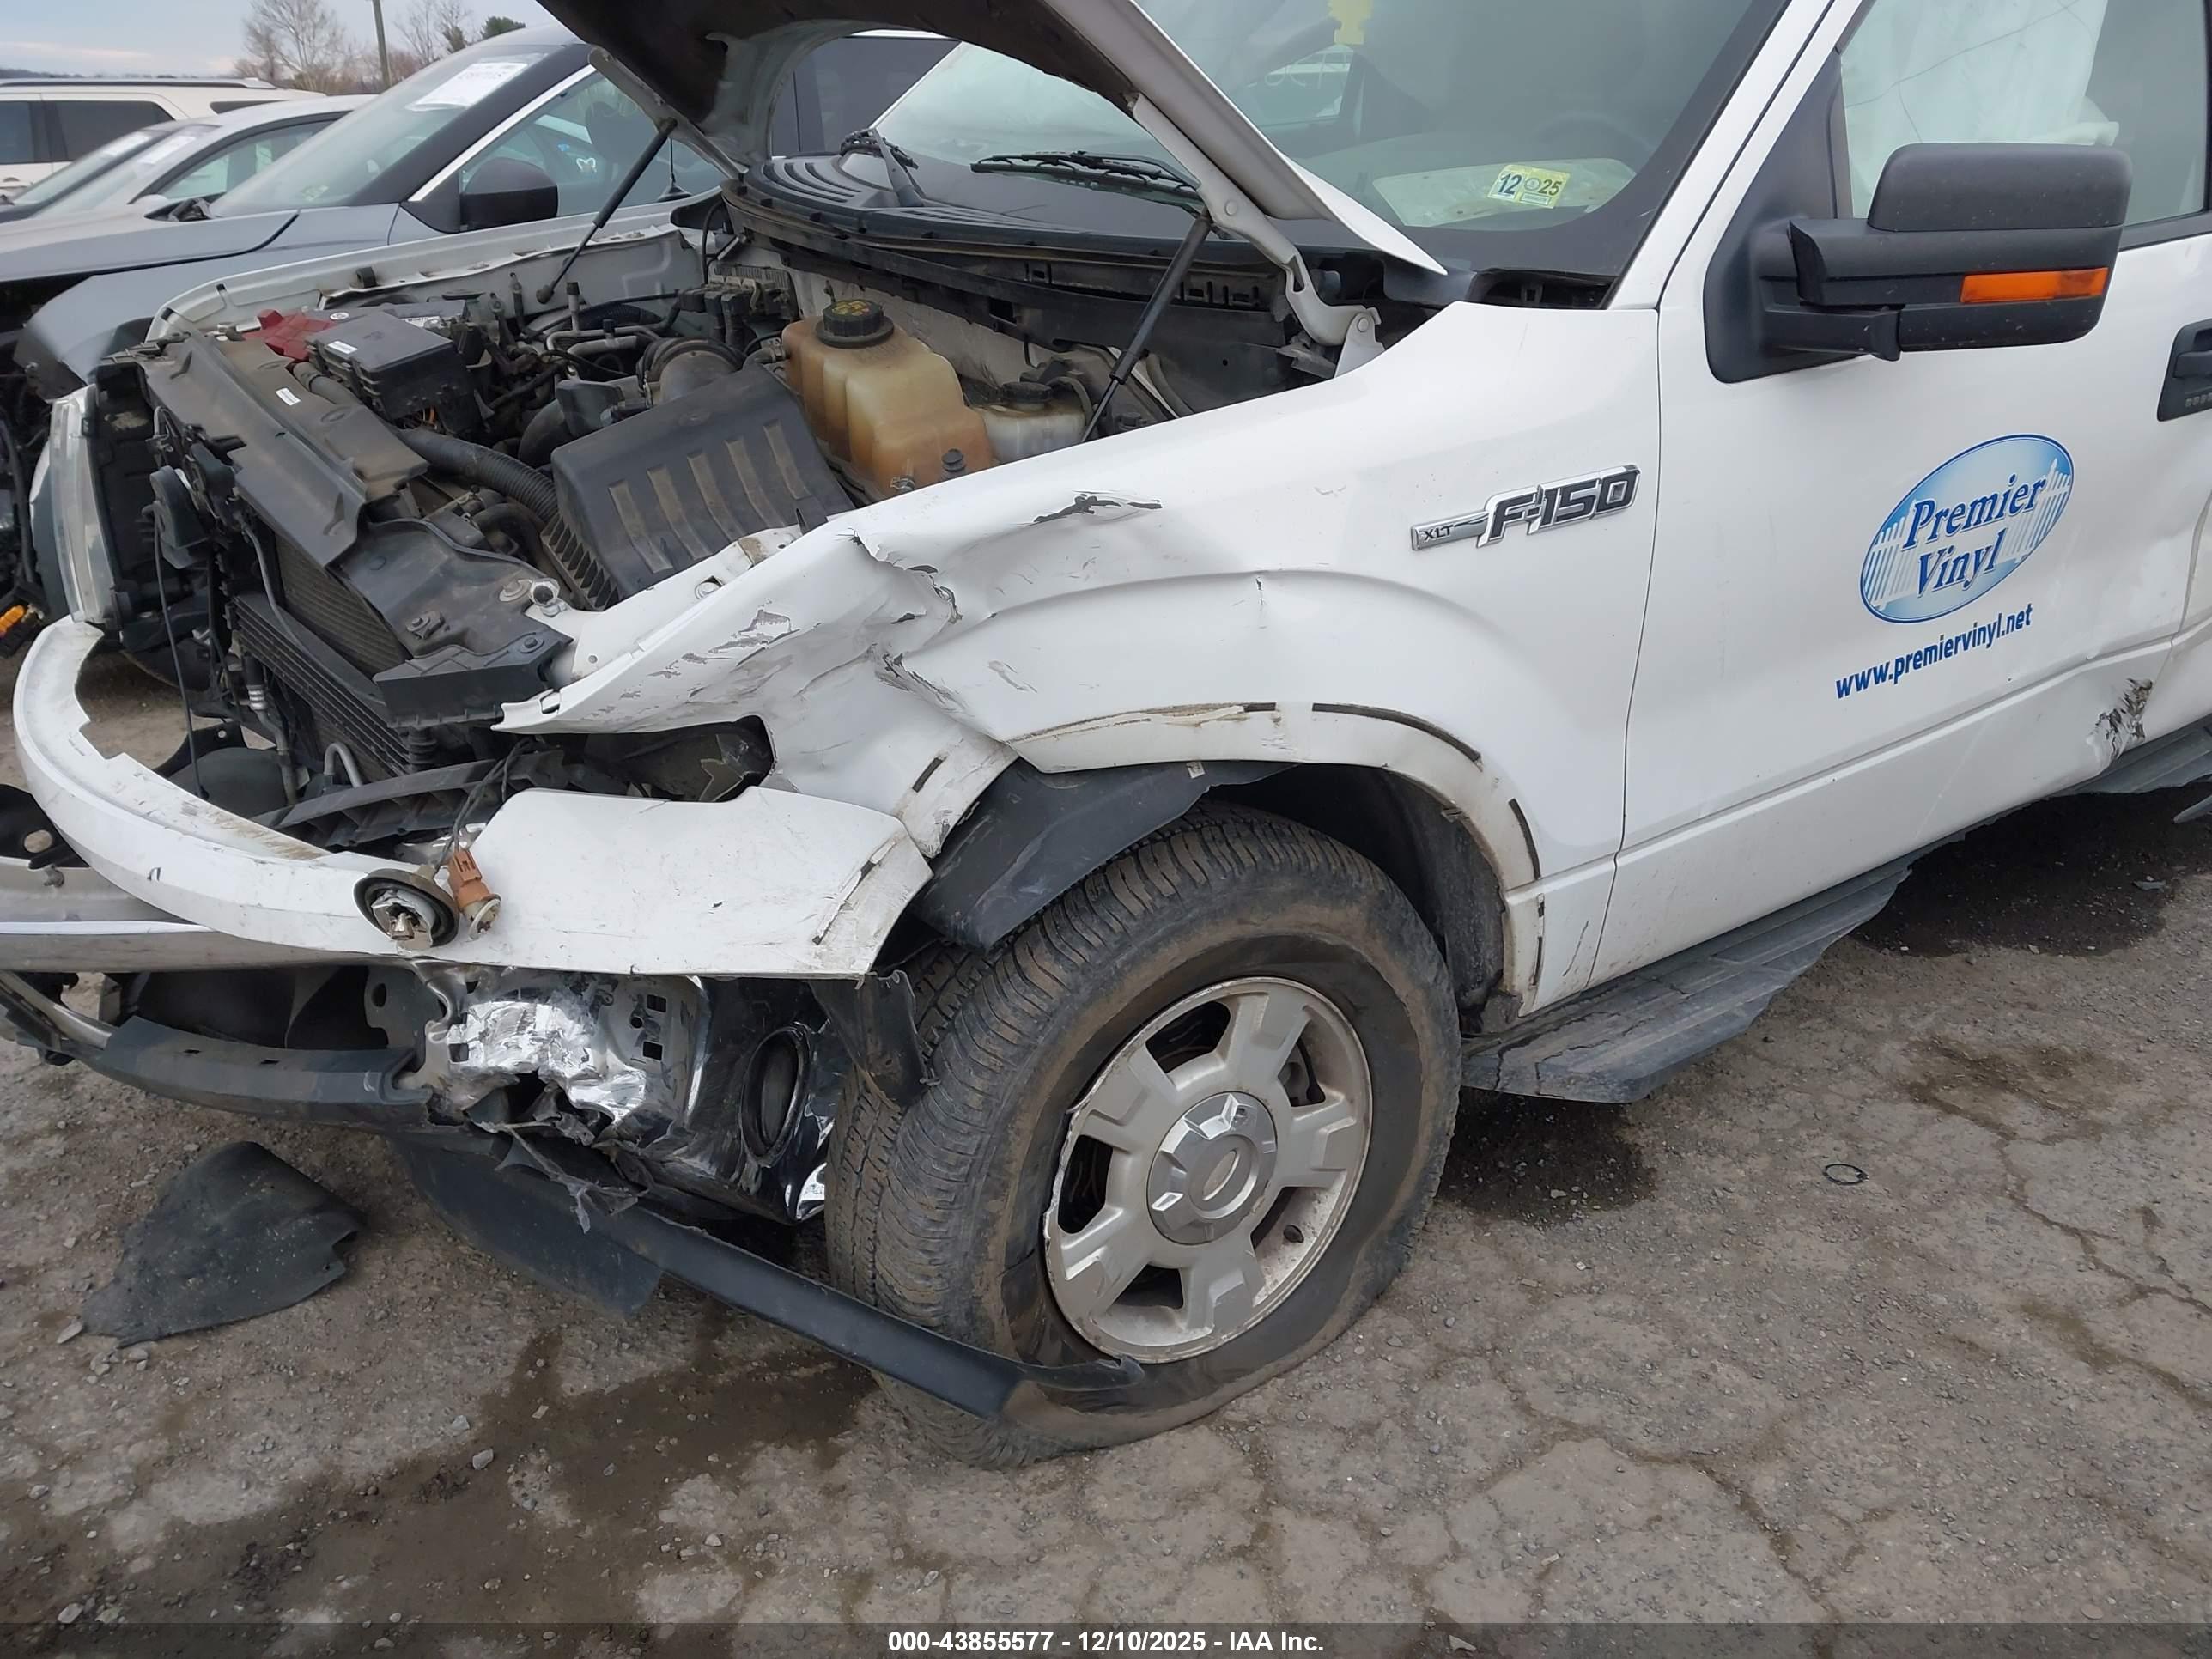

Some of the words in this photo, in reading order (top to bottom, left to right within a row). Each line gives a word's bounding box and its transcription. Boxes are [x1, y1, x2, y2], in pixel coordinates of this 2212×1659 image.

[1497, 173, 1522, 195] 12
[1538, 179, 1562, 196] 25
[1423, 524, 1453, 542] XLT
[1478, 465, 1641, 547] F-150
[1902, 473, 2047, 550] Premier
[1917, 527, 2006, 597] Vinyl
[1835, 603, 2033, 698] www.premiervinyl.net
